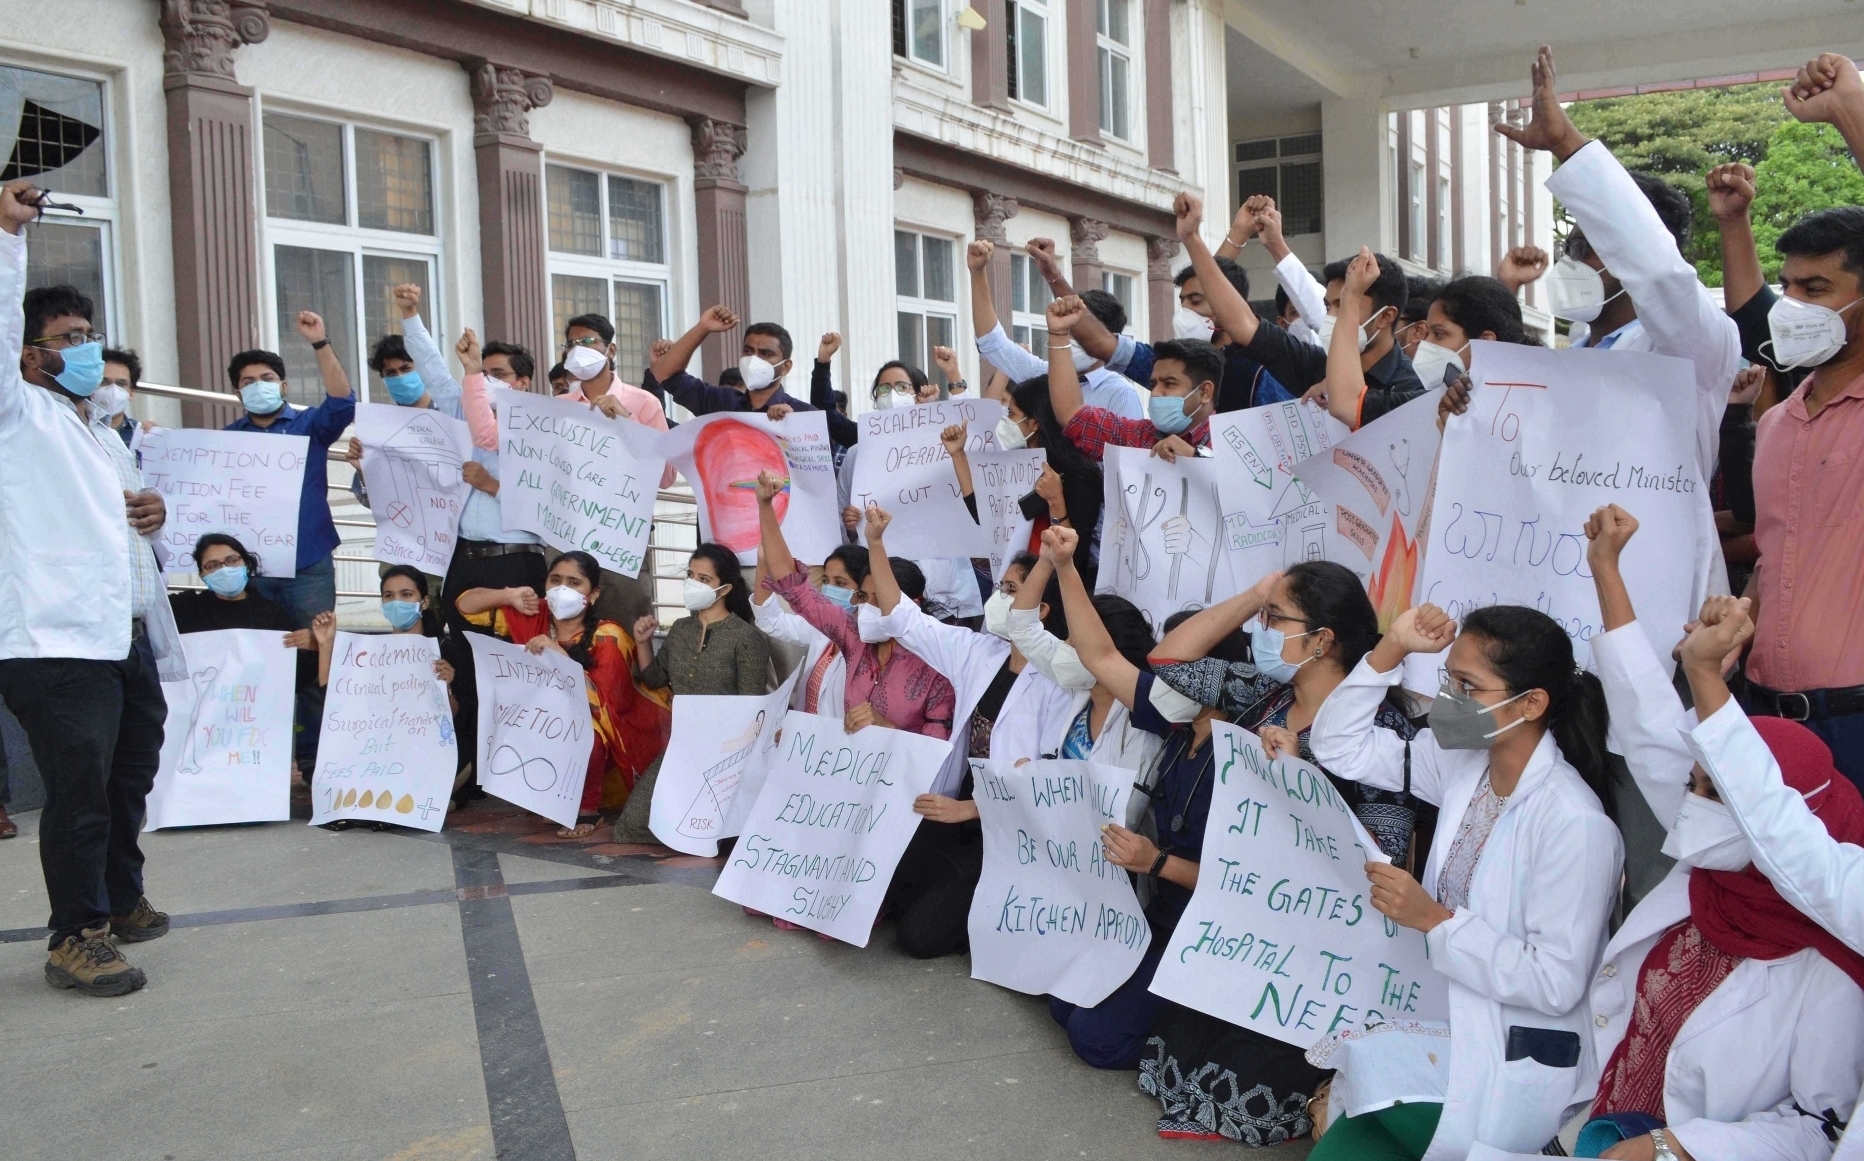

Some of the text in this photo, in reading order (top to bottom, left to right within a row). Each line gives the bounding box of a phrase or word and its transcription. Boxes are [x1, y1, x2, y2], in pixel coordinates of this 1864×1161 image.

[868, 401, 976, 436] SCALPELS TO
[1286, 406, 1300, 428] MD
[508, 405, 616, 458] EXCLUSIVE
[278, 451, 307, 471] OF
[1243, 451, 1266, 476] ENT
[1510, 451, 1697, 494] Our beloved Minister
[229, 478, 267, 499] FEE
[577, 460, 608, 488] CARE
[615, 473, 641, 503] IN
[430, 497, 447, 510] NO
[517, 469, 648, 539] ALL GOVERNMENT
[898, 485, 931, 504] CUT
[176, 503, 251, 525] FOR THE
[1225, 514, 1248, 532] MD
[1286, 506, 1321, 525] MEDICAL
[251, 527, 296, 547] YEAR
[379, 535, 414, 560] Since
[536, 502, 643, 572] MEDICAL COLLEGES
[211, 685, 258, 703] WHEN
[225, 706, 257, 723] WILL
[203, 725, 233, 748] YOU
[408, 726, 426, 737] on
[359, 733, 396, 756] But
[787, 731, 894, 787] MEDICAL
[317, 762, 405, 786] FEES PAID
[971, 764, 1016, 802] TILL
[1031, 775, 1084, 808] WHEN
[689, 818, 714, 830] RISK
[775, 793, 887, 834] EDUCATION
[1289, 813, 1341, 861] TAKE
[1016, 828, 1037, 866] BE
[1046, 840, 1081, 873] OUR
[1218, 857, 1261, 895] THE
[1267, 879, 1363, 927] GATES
[995, 885, 1147, 951] KITCHEN APRON
[1180, 920, 1292, 977] HOSPITAL
[1378, 962, 1421, 1013] THE
